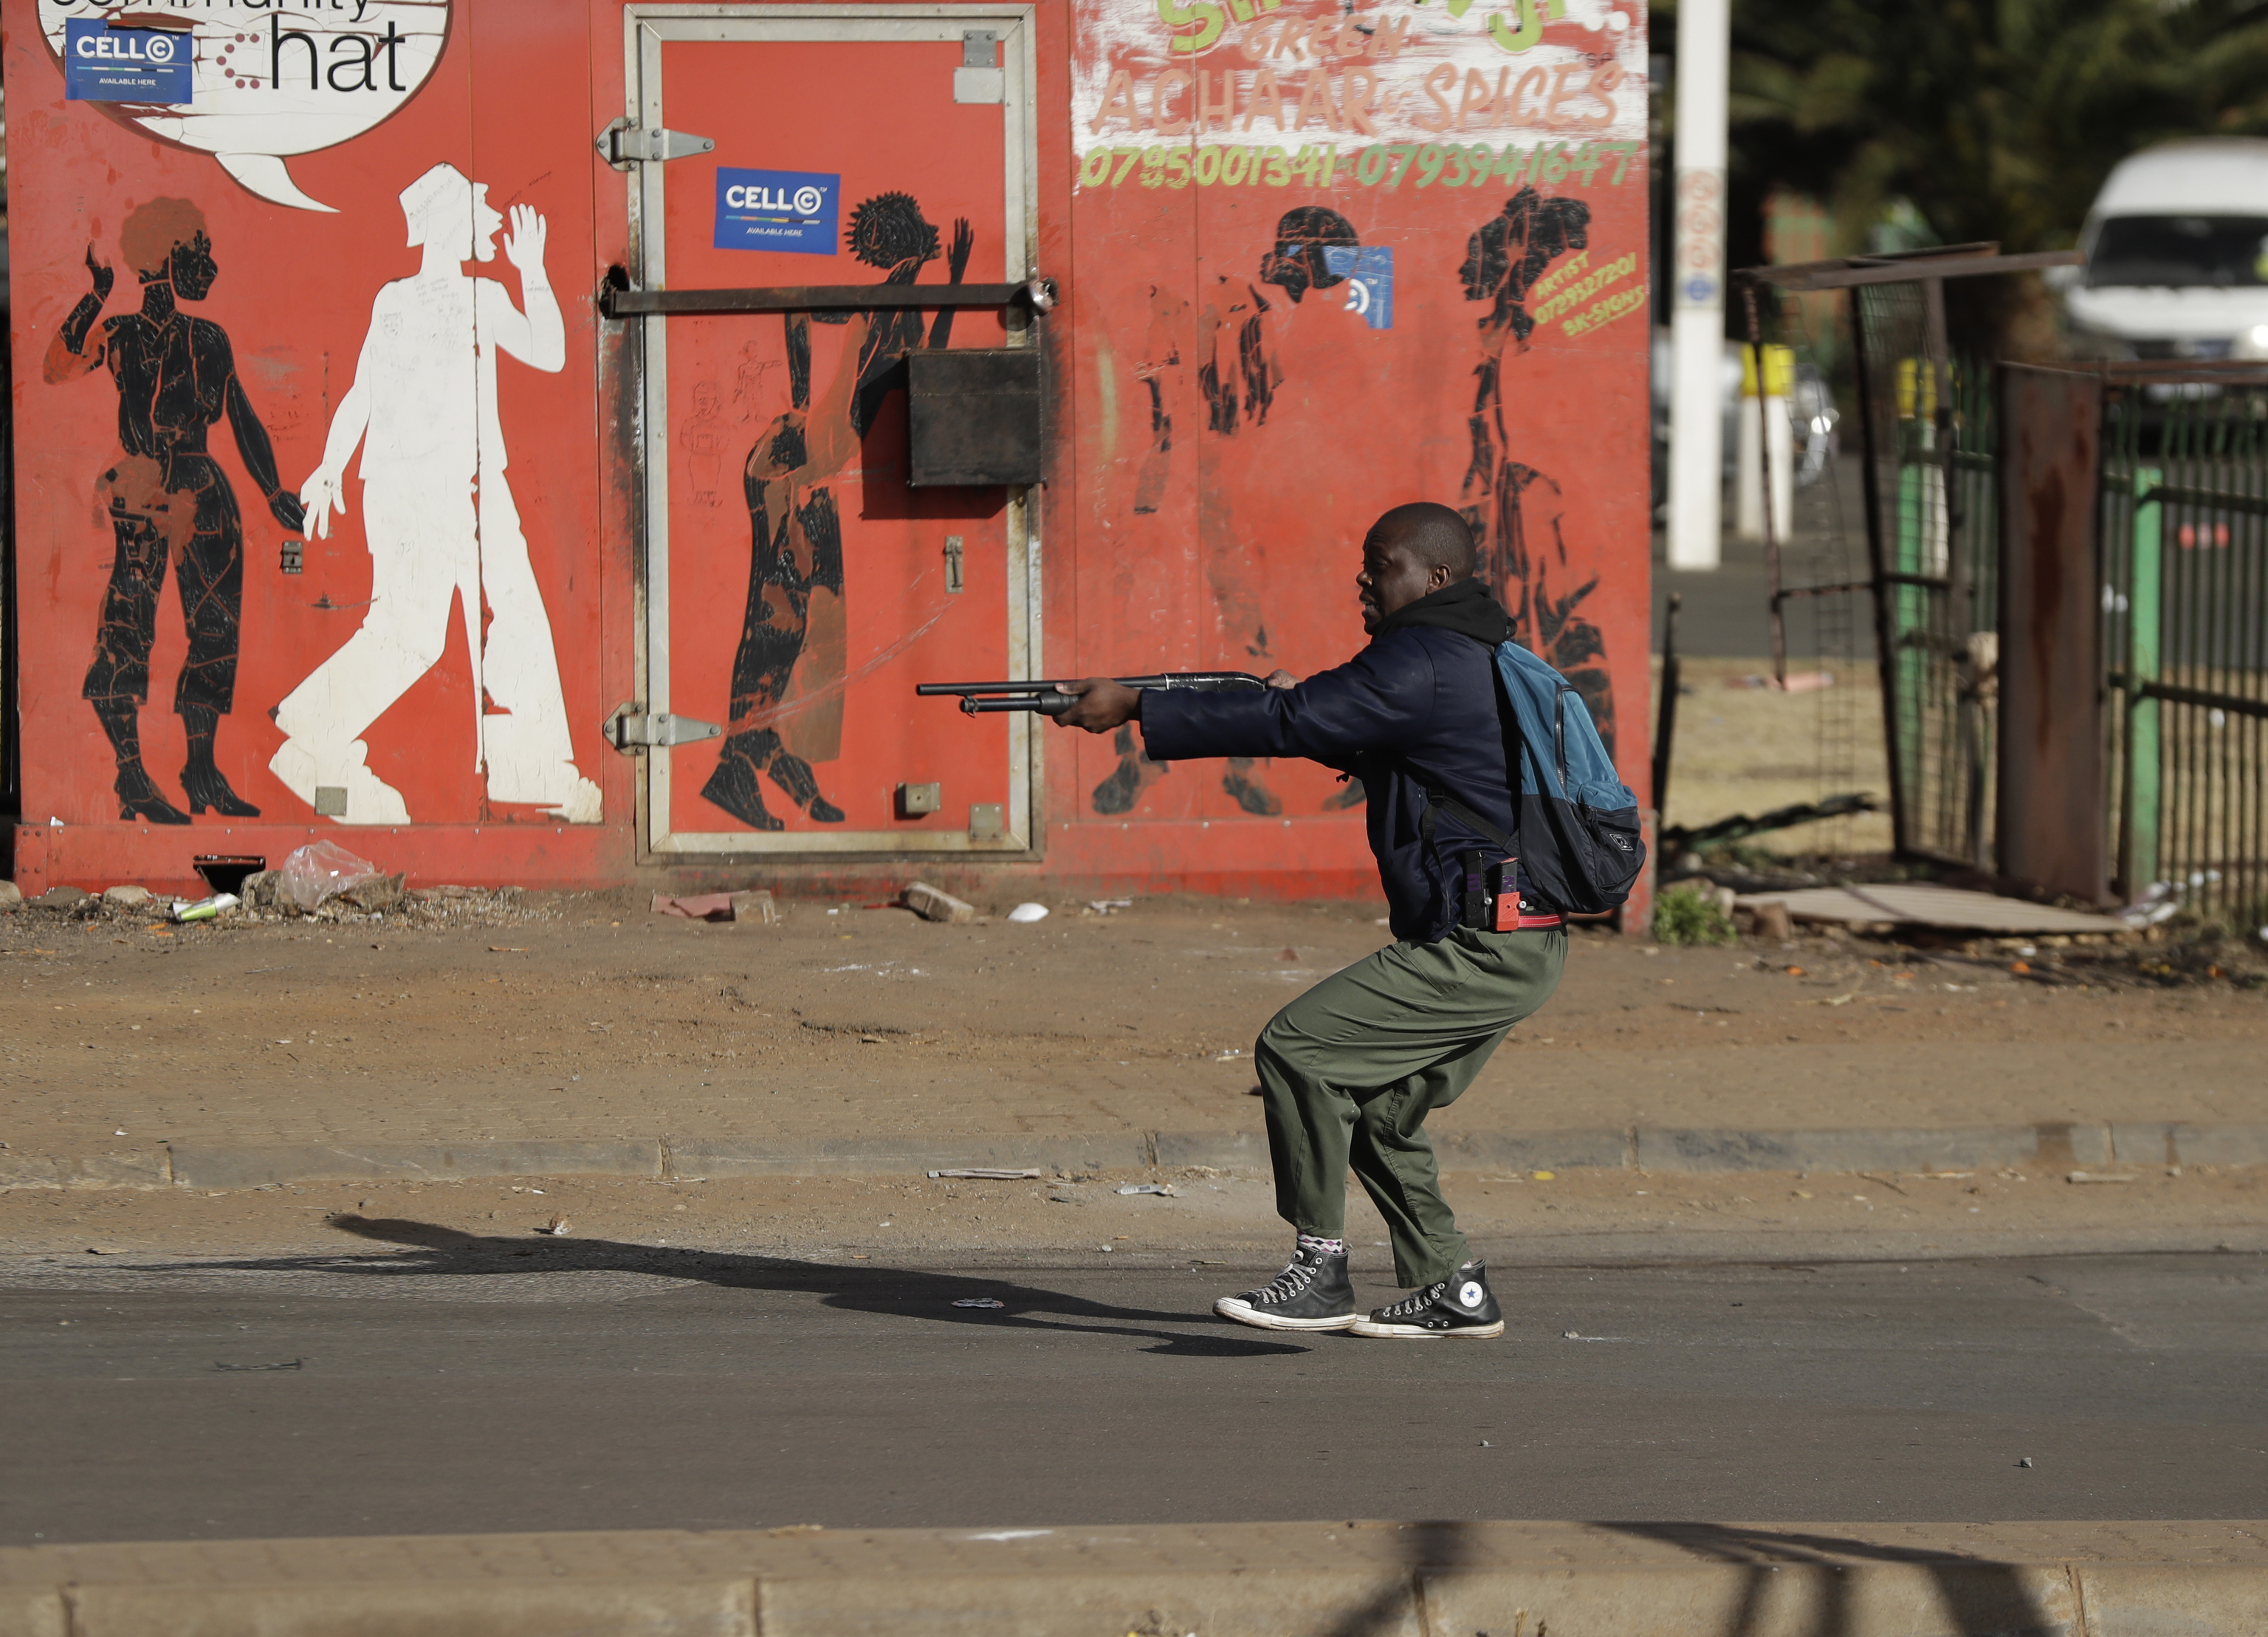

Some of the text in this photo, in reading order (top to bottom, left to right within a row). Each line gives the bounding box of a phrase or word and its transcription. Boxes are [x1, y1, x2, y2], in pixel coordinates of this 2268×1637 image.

[1241, 13, 1411, 62] GREEN
[99, 78, 136, 86] AVAILABLE
[1090, 66, 1378, 137] ACHAAR
[1424, 61, 1626, 132] SPICES
[1358, 140, 1639, 188] 0793941647
[746, 227, 803, 237] AVAILABLE HERE
[1534, 250, 1590, 300] ARTIST
